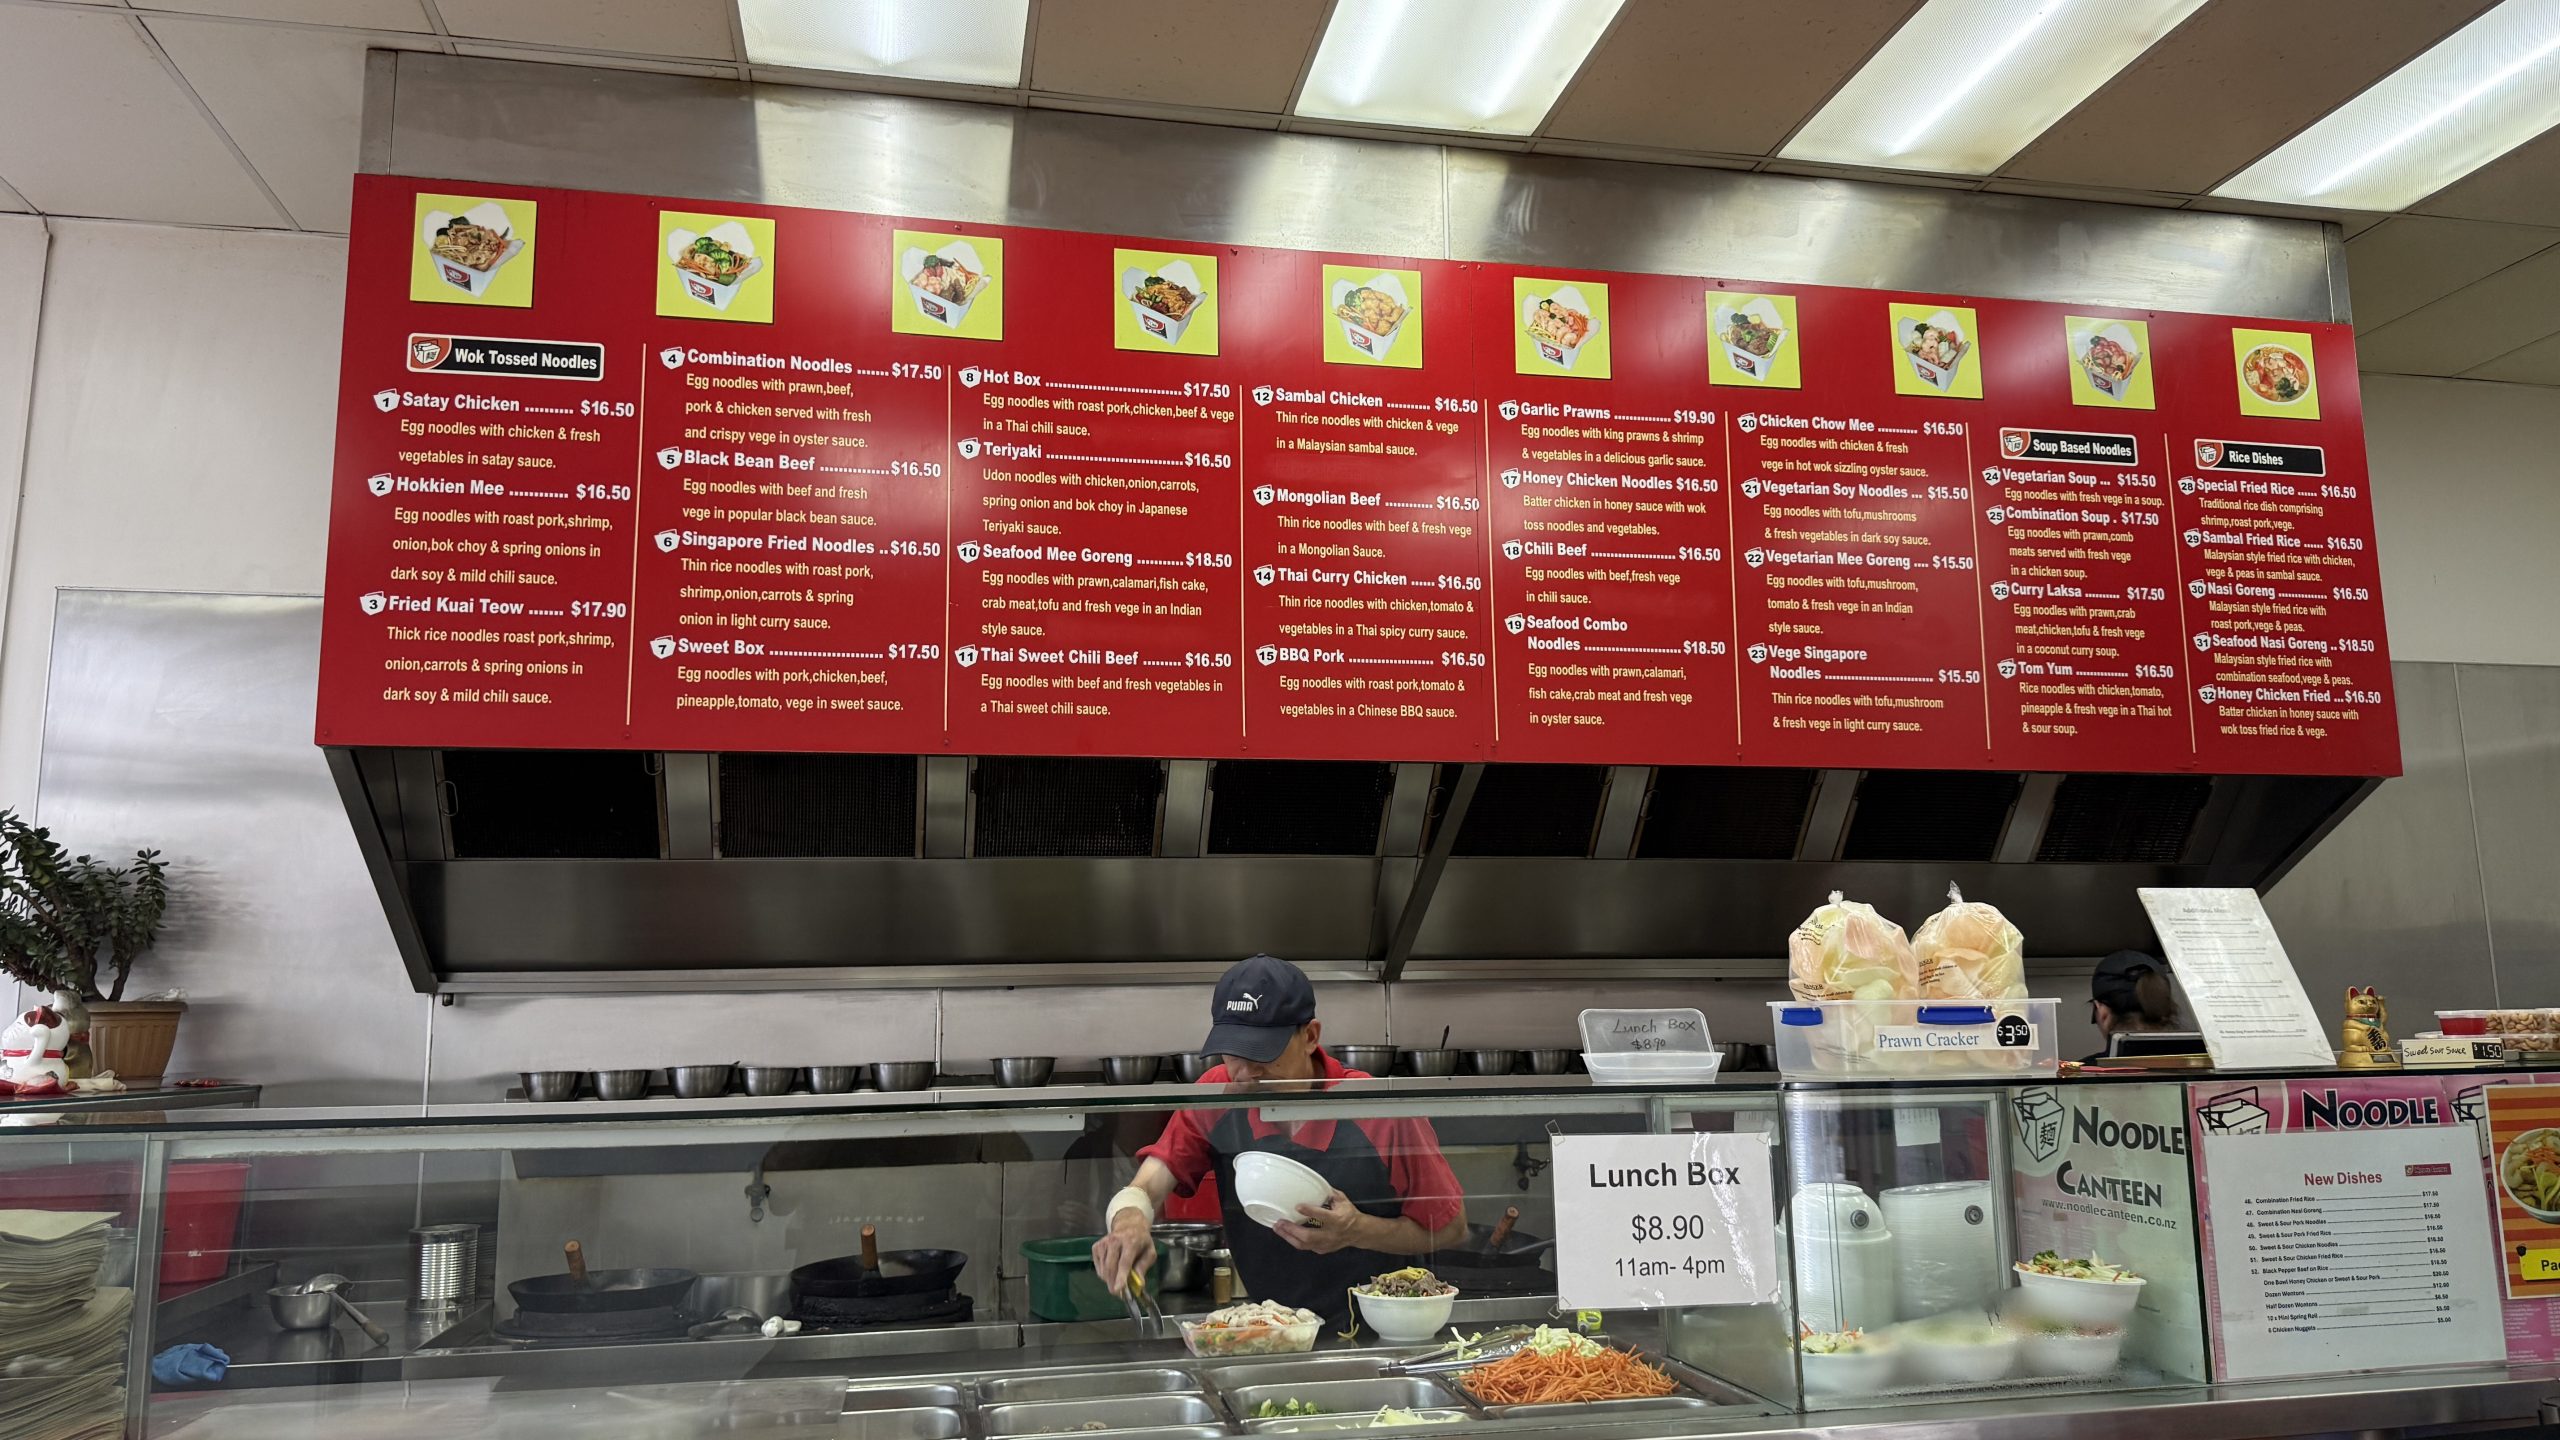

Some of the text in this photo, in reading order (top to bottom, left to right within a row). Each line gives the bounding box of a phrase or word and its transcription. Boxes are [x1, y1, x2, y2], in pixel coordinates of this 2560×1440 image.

[455, 348, 597, 369] Wok Tossed Noodles
[668, 349, 941, 380] 4 Combination Noodles $17.50
[687, 373, 709, 390] Egg
[713, 376, 758, 390] noodles
[761, 378, 785, 391] with
[383, 391, 634, 417] 1 Satay Chicken $16.50
[1255, 388, 1478, 413] 12 Sambal Chicken $16.50
[1502, 402, 1715, 424] 16 Garlic Prawns $19.90
[401, 419, 600, 442] Egg noodles with chicken & fresh
[1741, 414, 1963, 435] 20 Chicken Chow Mee $16.50
[965, 441, 1231, 468] 9 Teriyaki $16.50
[1276, 437, 1417, 456] in a Malaysian sambal sauce.
[2033, 439, 2132, 456] Soup Based Noodles
[399, 450, 556, 469] vegetables in satay sauce.
[2229, 450, 2283, 465] Rice Dishes
[983, 468, 1011, 482] Udon
[1015, 471, 1057, 484] noodles
[1060, 473, 1082, 485] with
[2181, 478, 2356, 498] 28 Special Fried Rice $16.50
[2198, 497, 2323, 517] Traditional rice dish comprising
[664, 531, 940, 556] 6 Singapore Fried Noodles $16.50
[1505, 541, 1721, 561] 18 Chili Beef $16.50
[1748, 549, 1973, 570] 22 Vegetarian Mee Goreng $15.50
[1525, 566, 1544, 581] Egg
[1547, 568, 1584, 580] noodles
[1587, 569, 1607, 580] with
[1658, 574, 1680, 585] vege
[1767, 574, 1785, 588] Egg
[1787, 575, 1824, 587] noodles
[1825, 576, 1845, 588] with
[1994, 582, 2165, 600] 26 Curry Laksa $17.50
[369, 595, 626, 618] 3 Fried Kuai Teow $17.90
[2013, 603, 2031, 617] Egg
[2033, 605, 2068, 616] noodles
[2069, 605, 2087, 616] with
[959, 647, 1231, 668] 11 Thai Sweet Chili Beef $16.50
[1259, 648, 1485, 666] 15 BBQ Pork $16.50
[1227, 1000, 1253, 1012] PUMA
[1612, 1018, 1696, 1033] Lunch Box
[1879, 1034, 1922, 1048] Prawn
[1926, 1032, 1979, 1047] Cracker
[2303, 1089, 2440, 1131] NOODLE
[2072, 1105, 2185, 1155] NOODLE
[1589, 1162, 1741, 1187] Lunch Box
[2056, 1160, 2162, 1208] CANTEEN
[2304, 1171, 2383, 1186] New Dishes
[2042, 1199, 2177, 1230] www.noodlecanteen.co.nz
[1632, 1214, 1704, 1243] $8.90
[1615, 1256, 1725, 1278] 11am- 4pm
[2541, 1259, 2560, 1271] Pa
